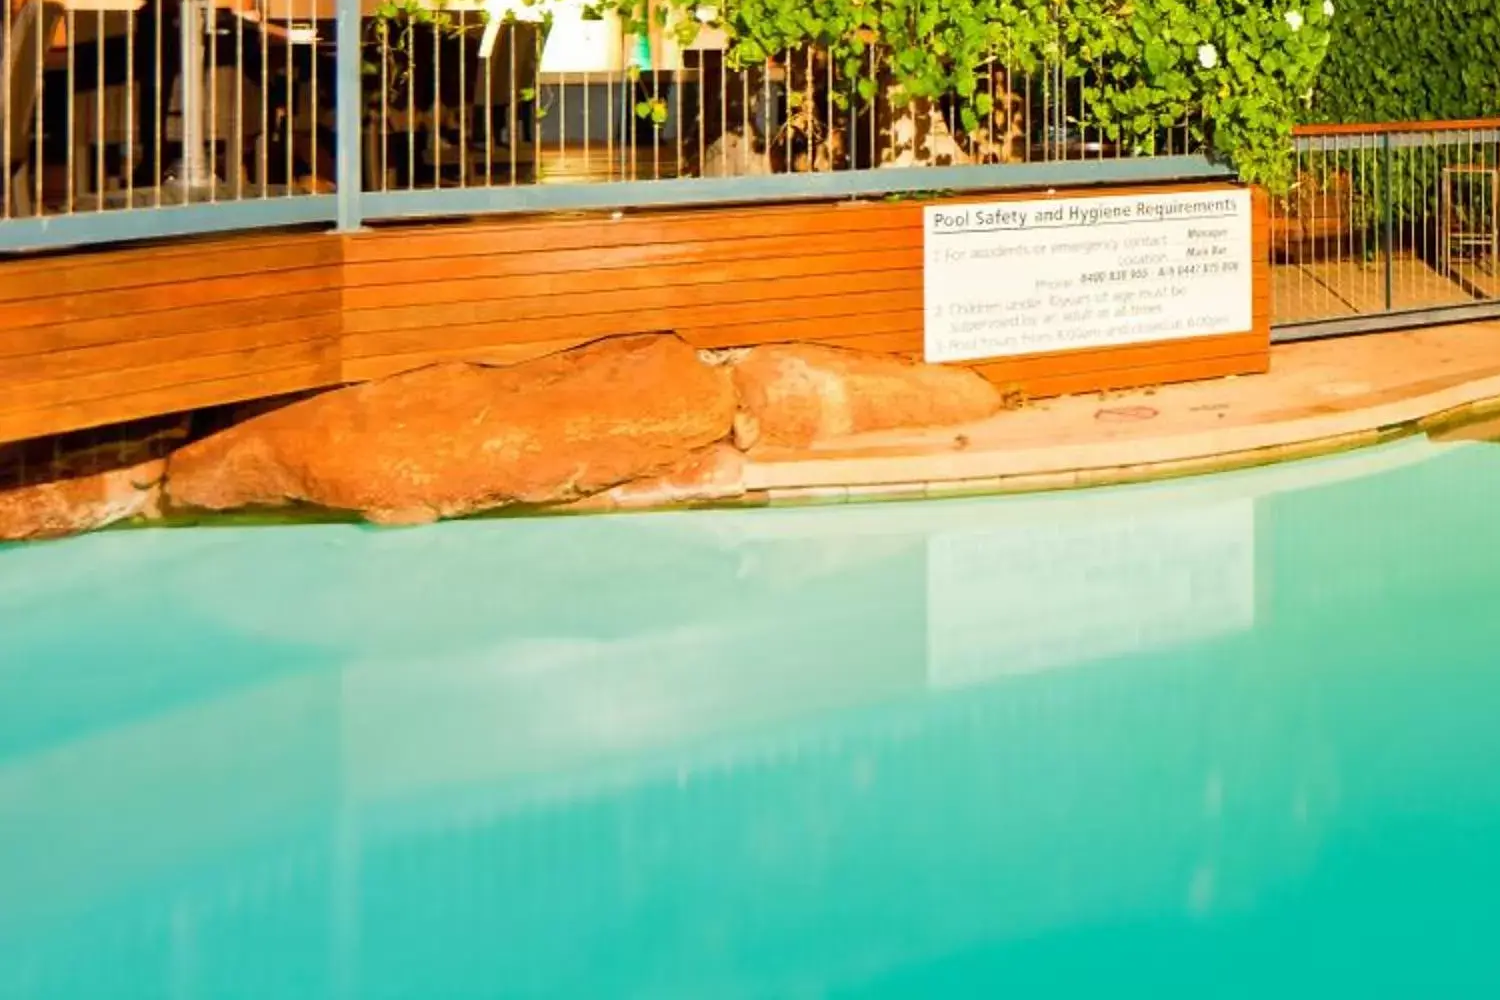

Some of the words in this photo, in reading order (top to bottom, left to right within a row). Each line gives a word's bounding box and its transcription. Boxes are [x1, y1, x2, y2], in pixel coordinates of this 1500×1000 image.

[933, 209, 970, 228] Pool
[975, 208, 1028, 229] Safety
[1034, 204, 1064, 222] and
[1069, 203, 1131, 226] Hygiene
[1136, 197, 1237, 220] Requirements
